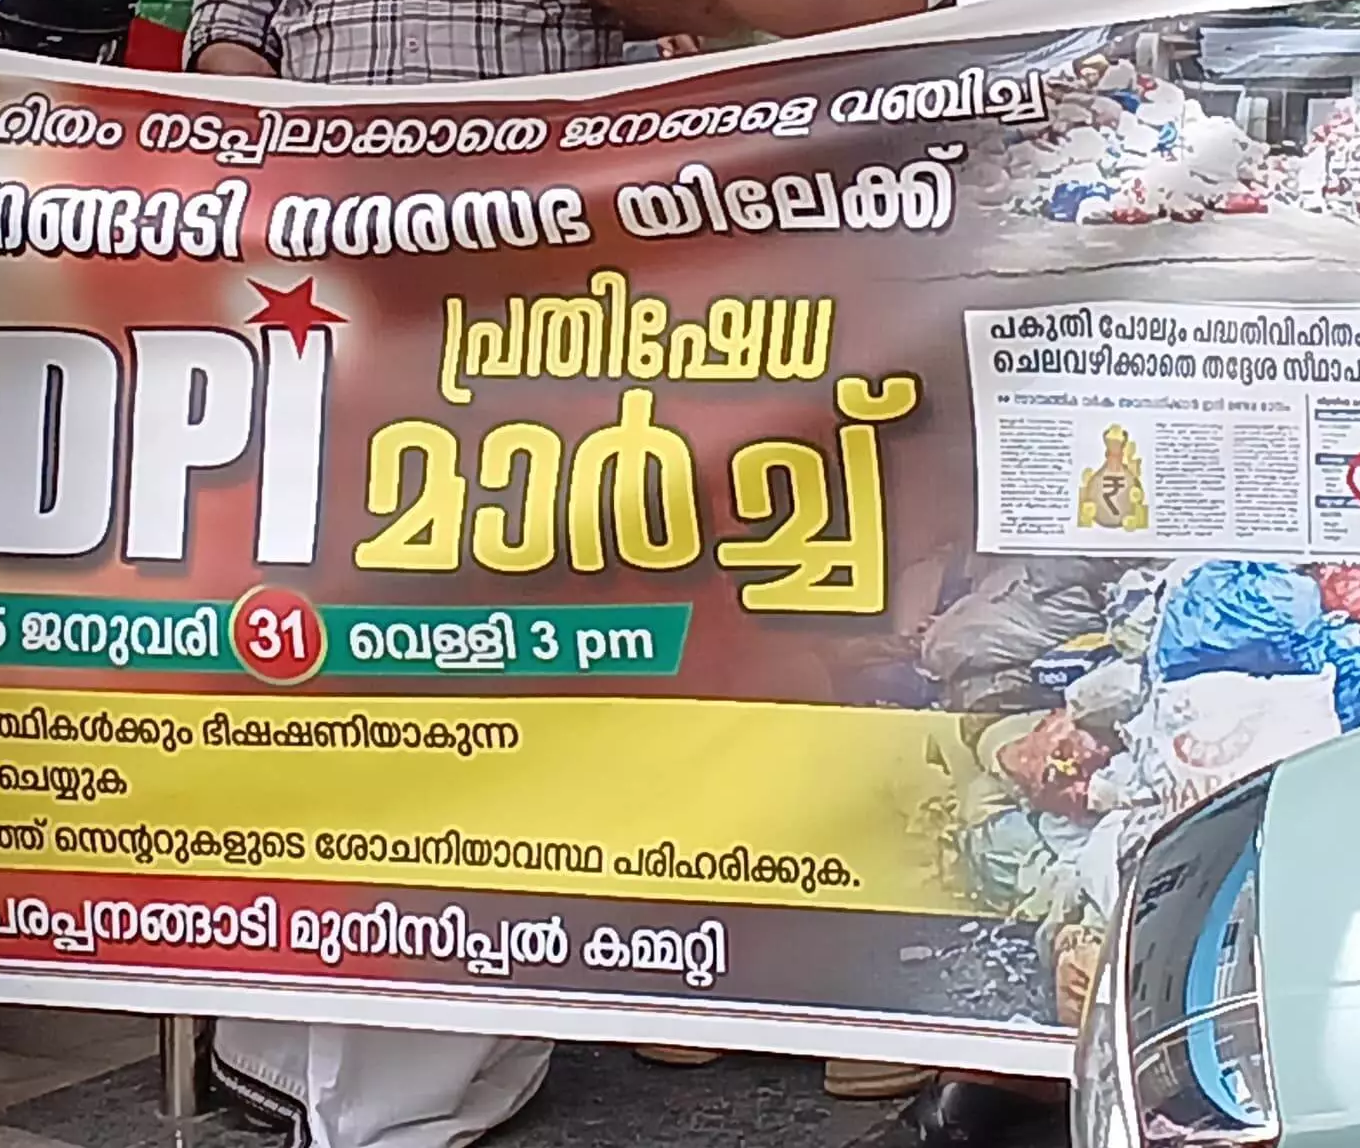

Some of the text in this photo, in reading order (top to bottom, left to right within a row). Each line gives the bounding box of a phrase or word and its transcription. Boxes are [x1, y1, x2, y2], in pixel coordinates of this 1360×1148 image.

[140, 109, 547, 165] നടപ്പിലാക്കാതെ
[559, 98, 816, 147] ജനങ്ങളെ
[830, 67, 1046, 125] വഞ്ചിച്ച
[268, 187, 591, 258] നഗരസഭ
[617, 143, 964, 239] യിലേക്ക്
[439, 270, 835, 404] പ്രതിഷേധ
[990, 307, 1093, 342] പകുതി
[1098, 315, 1188, 347] പോലും
[993, 344, 1197, 379] ചെലവഴിക്കാതെ
[352, 377, 918, 614] മാർച്ച്
[21, 606, 219, 667] ജനുവരി
[247, 607, 307, 659] 31
[349, 611, 518, 670] വെള്ളി
[530, 620, 559, 660] 3
[576, 626, 654, 669] pm
[202, 712, 520, 757] ഭീഷഷണിയാകുന്ന
[314, 829, 604, 873] ശോചനിയാവസ്ഥ
[613, 841, 861, 893] പരിഹരിക്കുക.
[289, 901, 569, 975] മുനിസിപ്പൽ
[582, 919, 726, 988] കമ്മറ്റി
